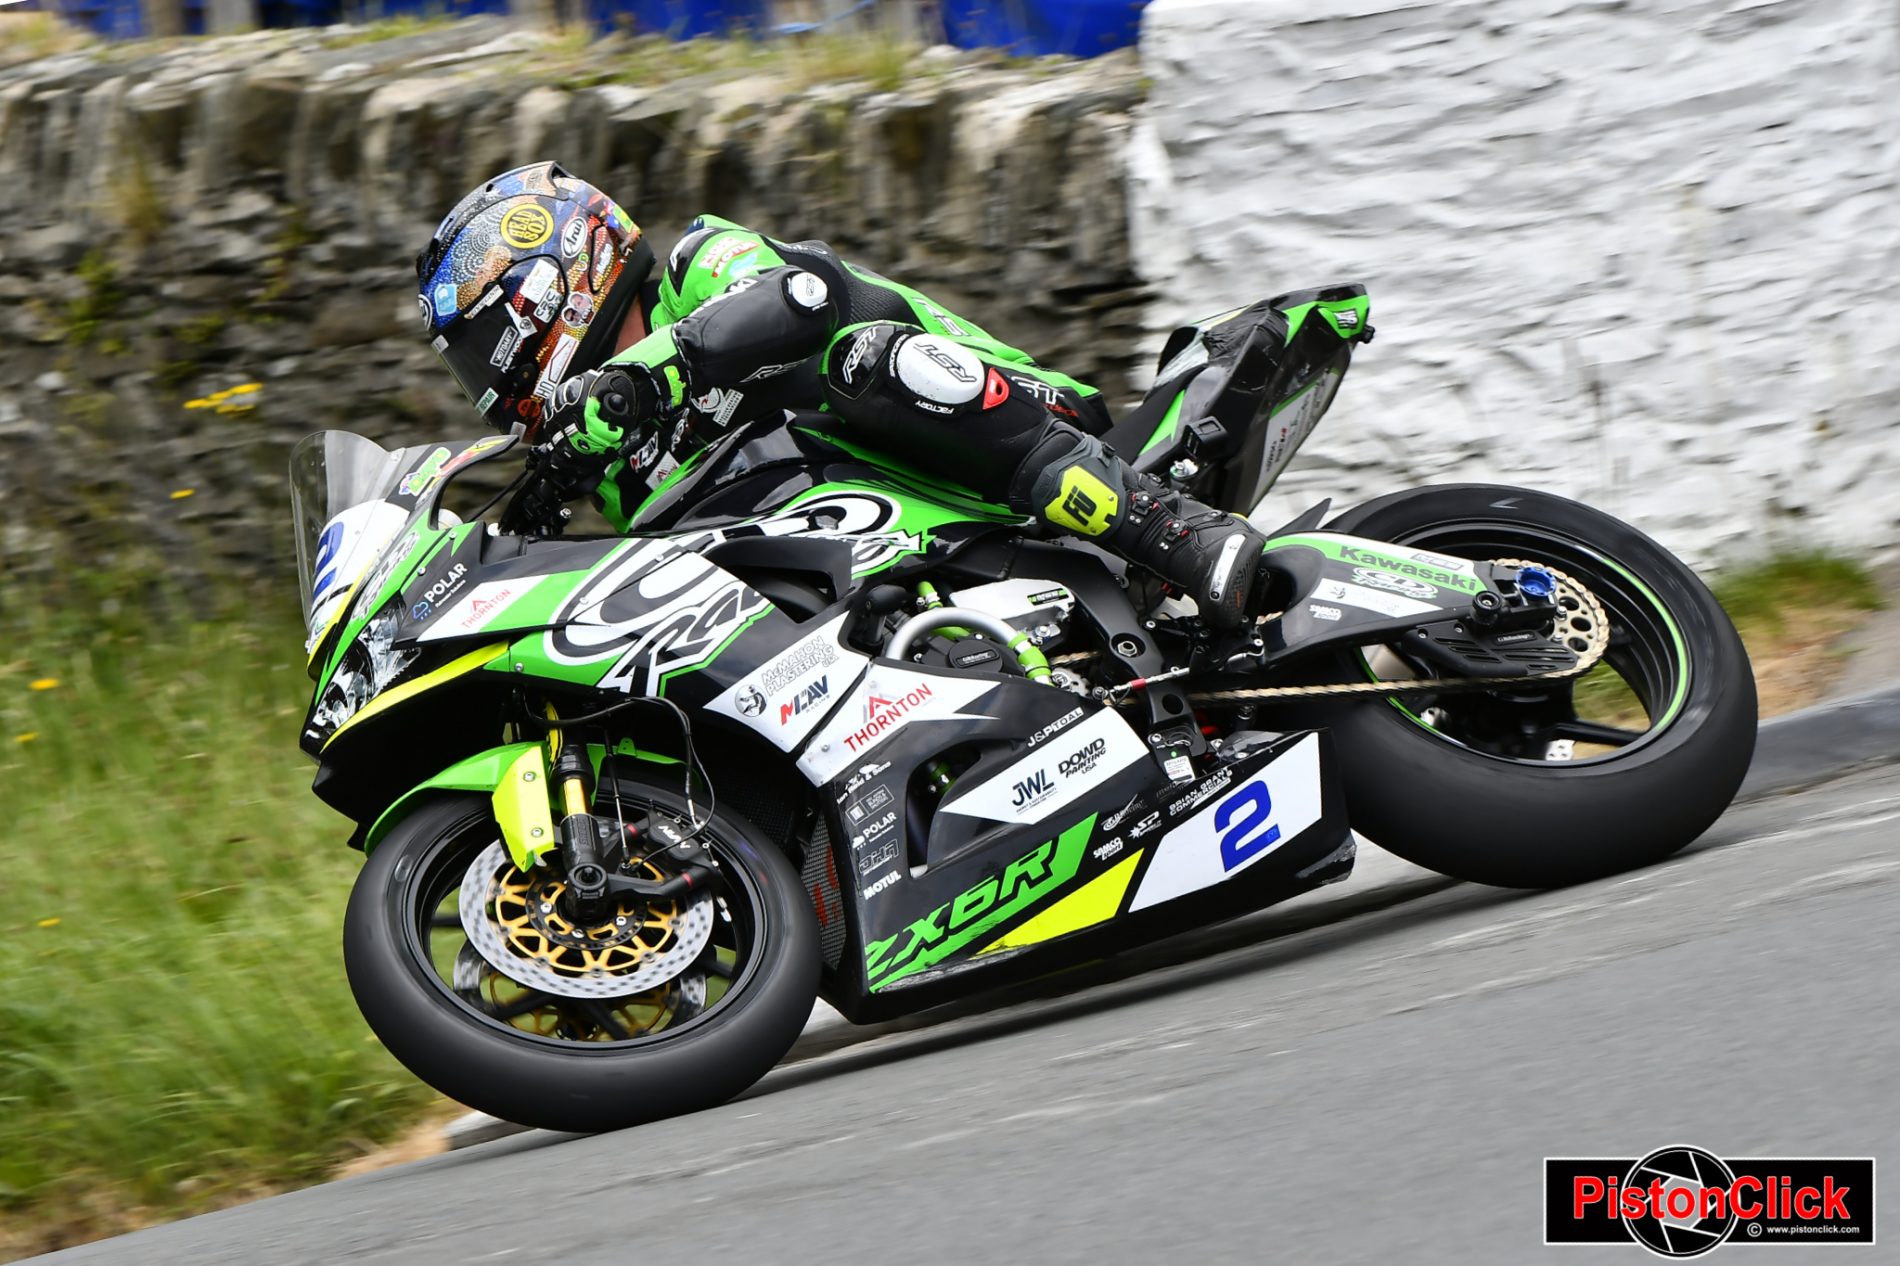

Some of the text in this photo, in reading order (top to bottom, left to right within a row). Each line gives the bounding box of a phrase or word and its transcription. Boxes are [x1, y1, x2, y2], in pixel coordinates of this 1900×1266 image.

[565, 220, 582, 256] Arai
[914, 343, 977, 382] RST
[424, 563, 468, 603] POLAR
[1340, 546, 1476, 591] Kawasaki
[461, 588, 511, 629] THORNTON
[766, 644, 834, 697] PLASTERING
[844, 682, 932, 752] THORNTON
[1058, 738, 1104, 774] DOWD
[1066, 748, 1106, 778] PAINTING
[1082, 762, 1096, 774] USA
[1012, 768, 1054, 806] JWL
[1169, 790, 1198, 810] BRIAN
[1200, 766, 1229, 788] GRANT
[1170, 770, 1233, 816] COMMERCIALS
[862, 812, 896, 838] POLAR
[1214, 780, 1281, 872] 2
[1094, 837, 1122, 859] SAMCO
[863, 870, 902, 900] MOTUL
[866, 840, 1052, 980] ZX6R
